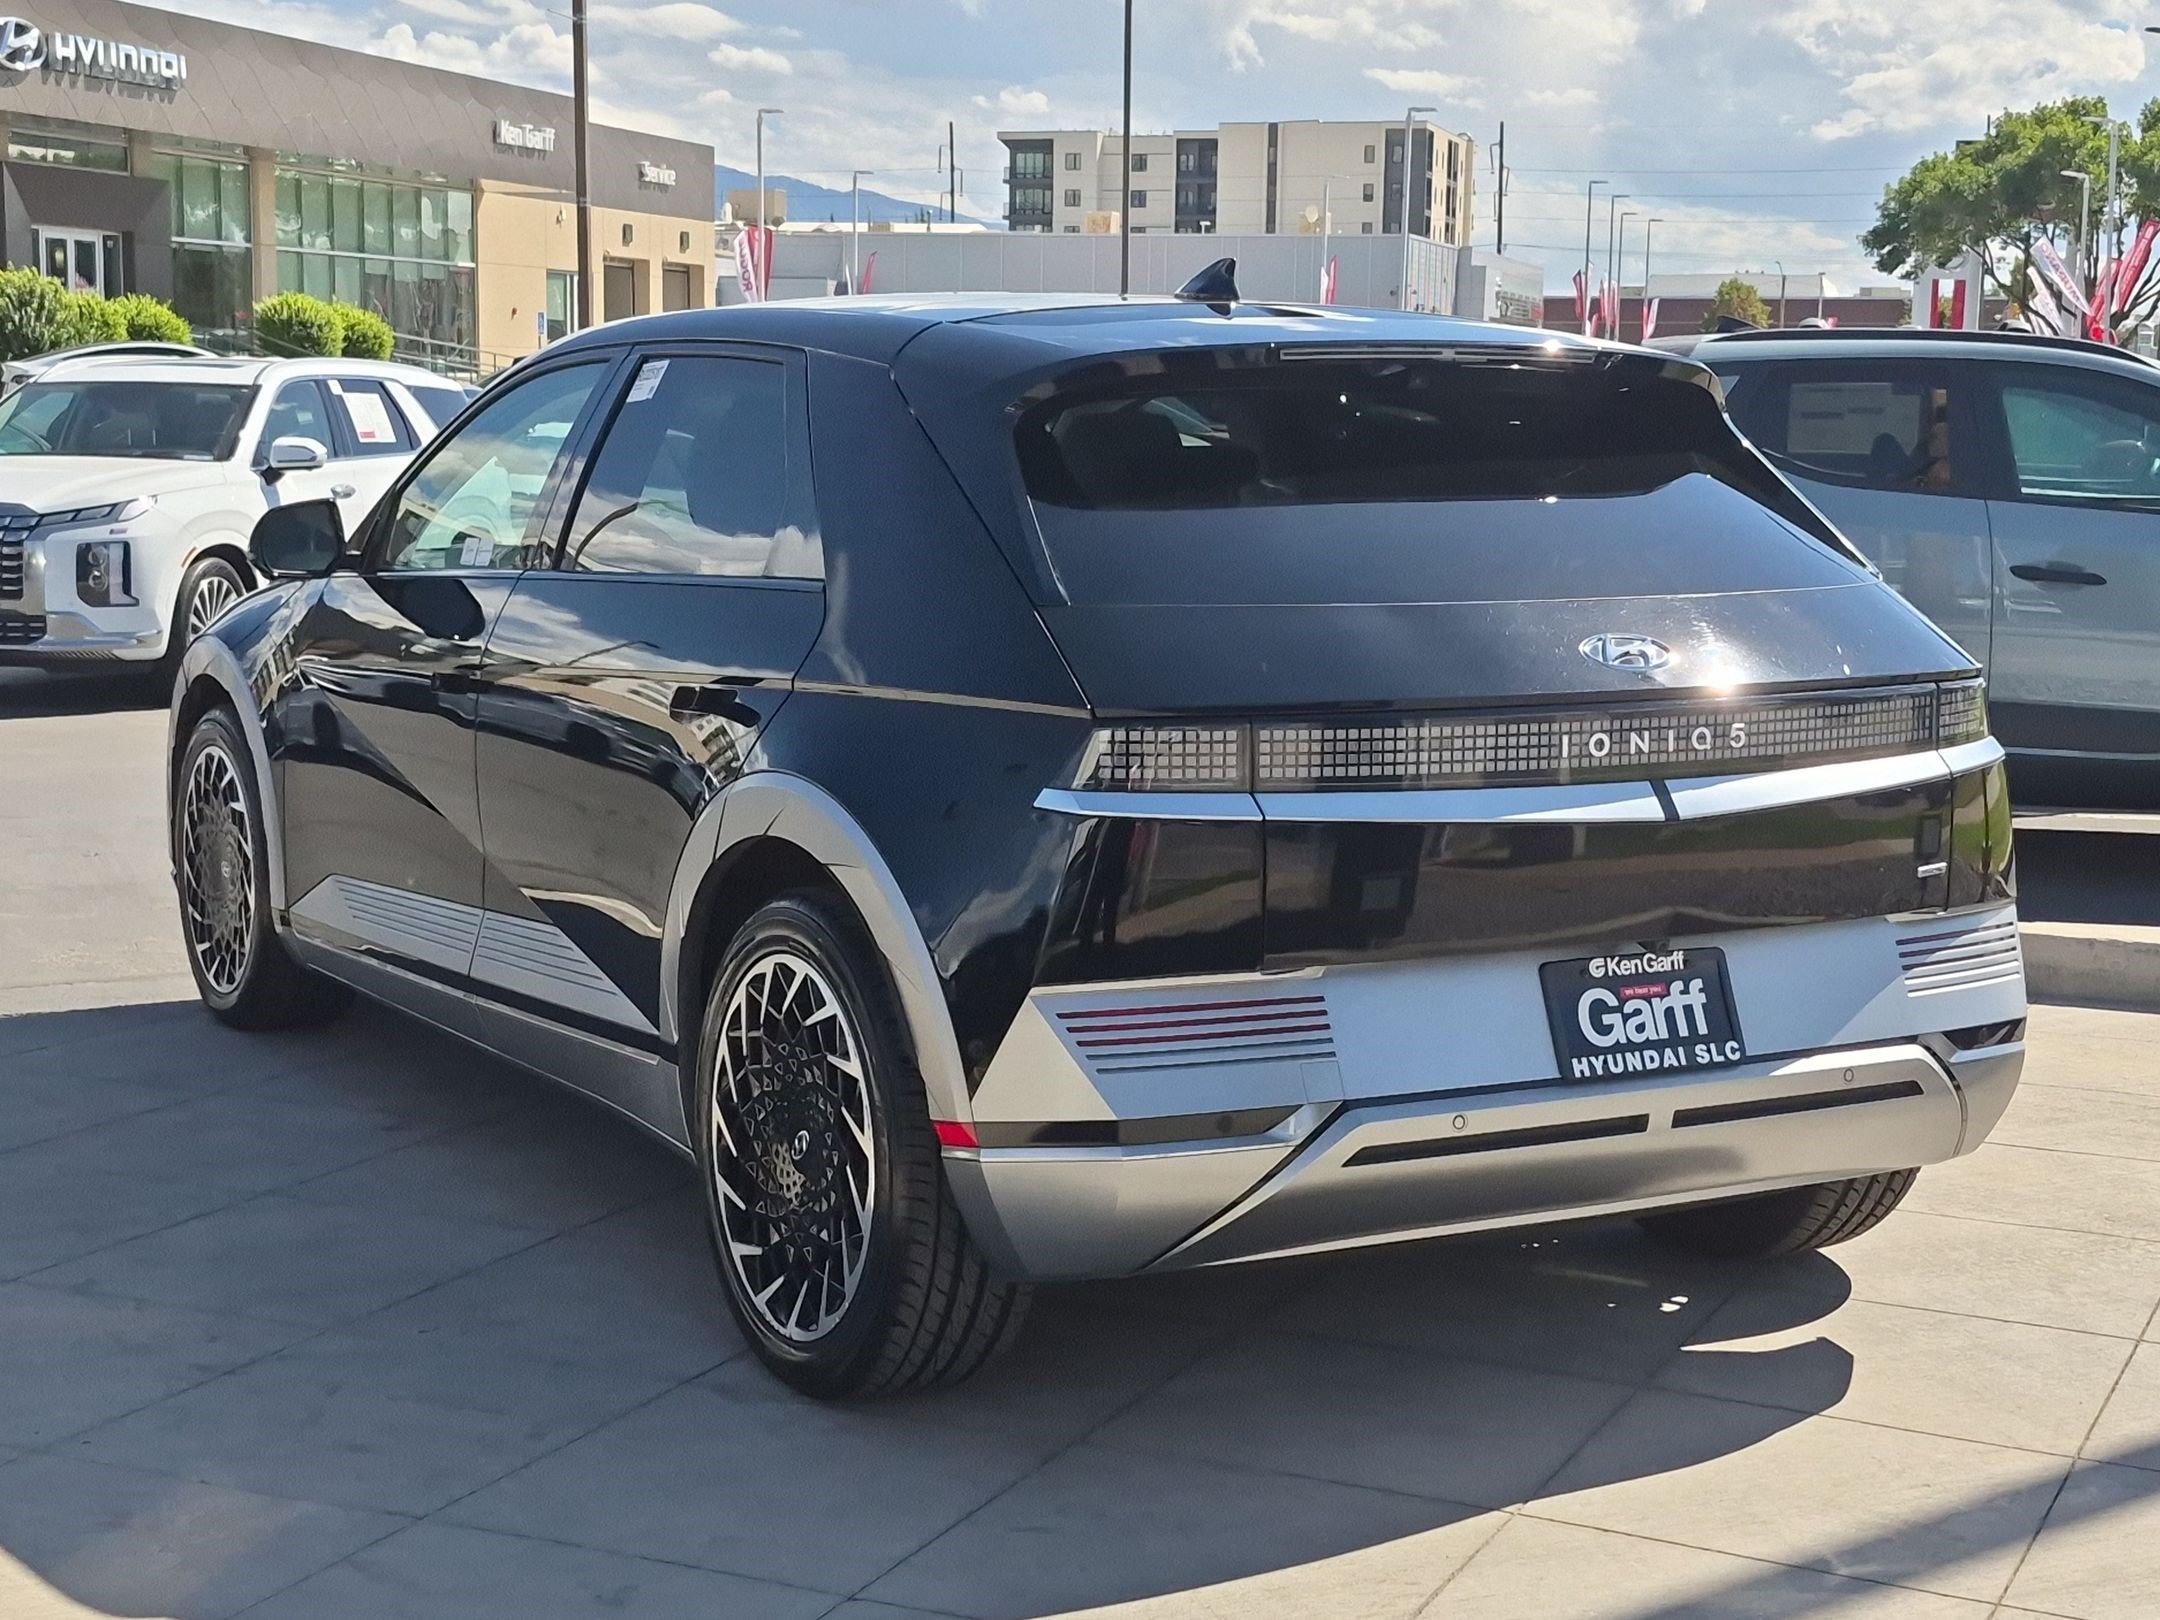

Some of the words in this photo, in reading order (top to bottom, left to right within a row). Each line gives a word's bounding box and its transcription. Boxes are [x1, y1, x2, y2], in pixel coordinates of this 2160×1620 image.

[54, 31, 188, 80] HYUNDAI
[1577, 977, 1709, 1048] Garff
[1571, 1045, 1688, 1079] HYUNDAI
[1694, 1040, 1742, 1064] SLC
